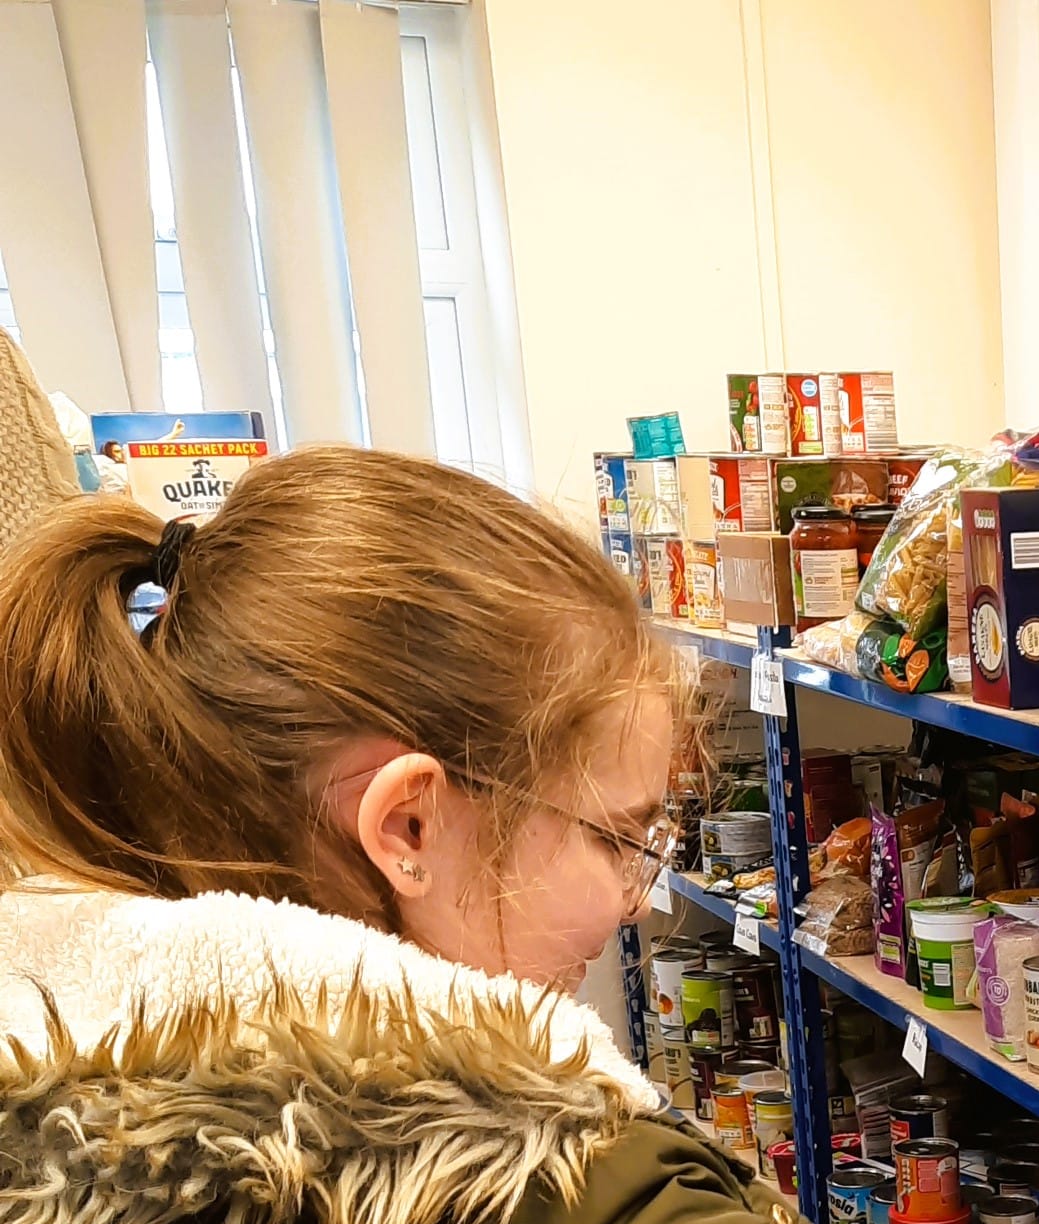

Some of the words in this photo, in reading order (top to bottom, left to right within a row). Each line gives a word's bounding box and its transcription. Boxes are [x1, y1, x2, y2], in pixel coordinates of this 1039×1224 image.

[139, 443, 159, 456] BIG
[163, 443, 177, 456] 22
[180, 443, 225, 455] SACHET
[228, 442, 259, 455] PACK
[162, 480, 233, 503] QUAKE
[181, 502, 198, 510] OAT
